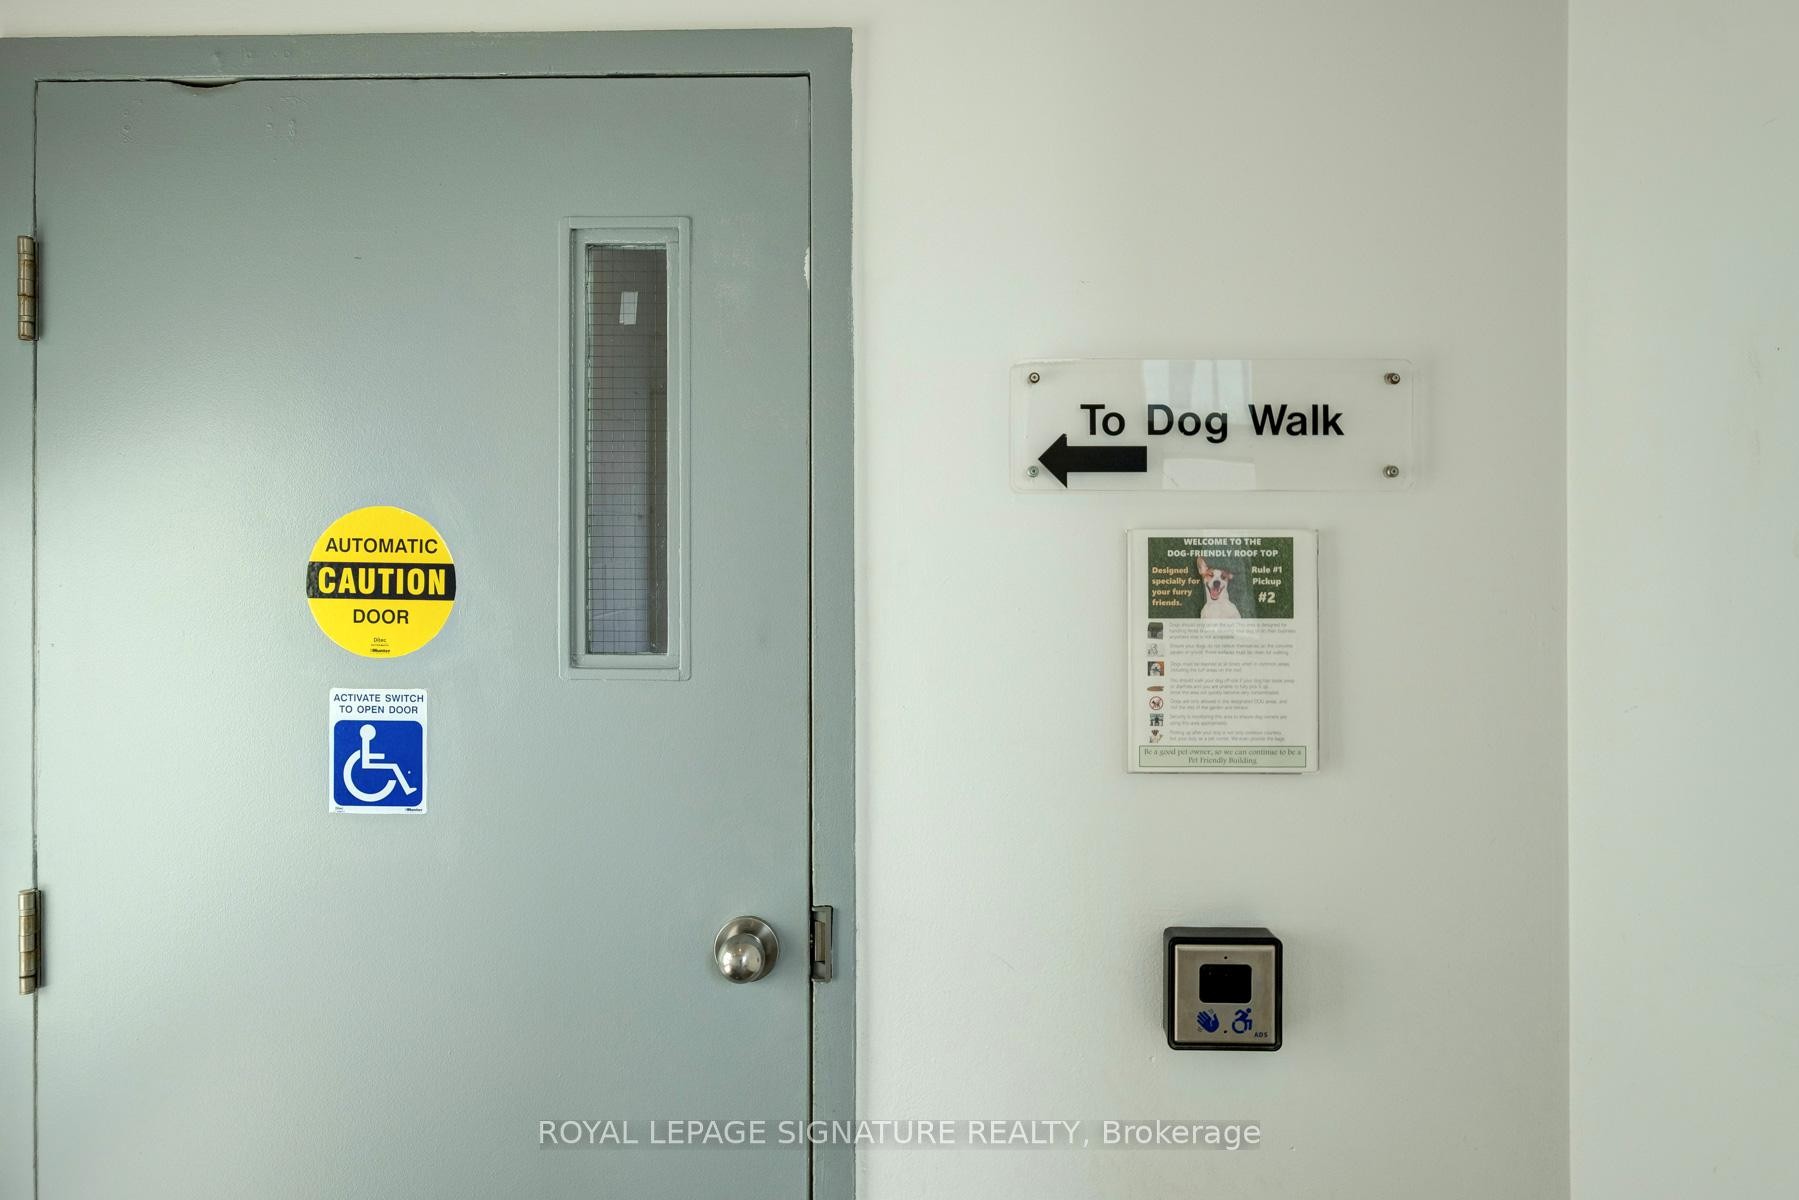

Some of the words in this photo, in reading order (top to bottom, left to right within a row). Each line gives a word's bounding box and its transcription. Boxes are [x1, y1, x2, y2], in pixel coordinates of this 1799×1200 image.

[1080, 404, 1125, 436] To
[1147, 404, 1228, 444] Dog
[1248, 404, 1344, 436] Walk
[325, 537, 438, 554] AUTOMATIC
[1167, 549, 1232, 557] DOG-FRIENDLY
[1234, 549, 1258, 557] ROOF
[1260, 549, 1279, 557] TOP
[1152, 567, 1189, 576] Designed
[1251, 566, 1271, 574] Rule
[1272, 566, 1283, 574] #1
[318, 566, 446, 596] CAUTION
[1152, 577, 1186, 586] specially
[1188, 577, 1200, 585] for
[1252, 577, 1282, 587] Pickup
[1172, 588, 1192, 597] furry
[1258, 592, 1276, 604] #2
[1152, 599, 1183, 607] friends.
[353, 609, 409, 624] DOOR
[333, 694, 381, 702] ACTIVATE
[385, 694, 424, 703] SWITCH
[339, 705, 353, 714] TO
[357, 705, 385, 714] OPEN
[389, 706, 418, 714] DOOR
[1159, 748, 1176, 757] good
[1177, 748, 1188, 757] pet
[1248, 748, 1278, 756] continue
[1287, 748, 1297, 756] be
[1200, 757, 1228, 766] Friendly
